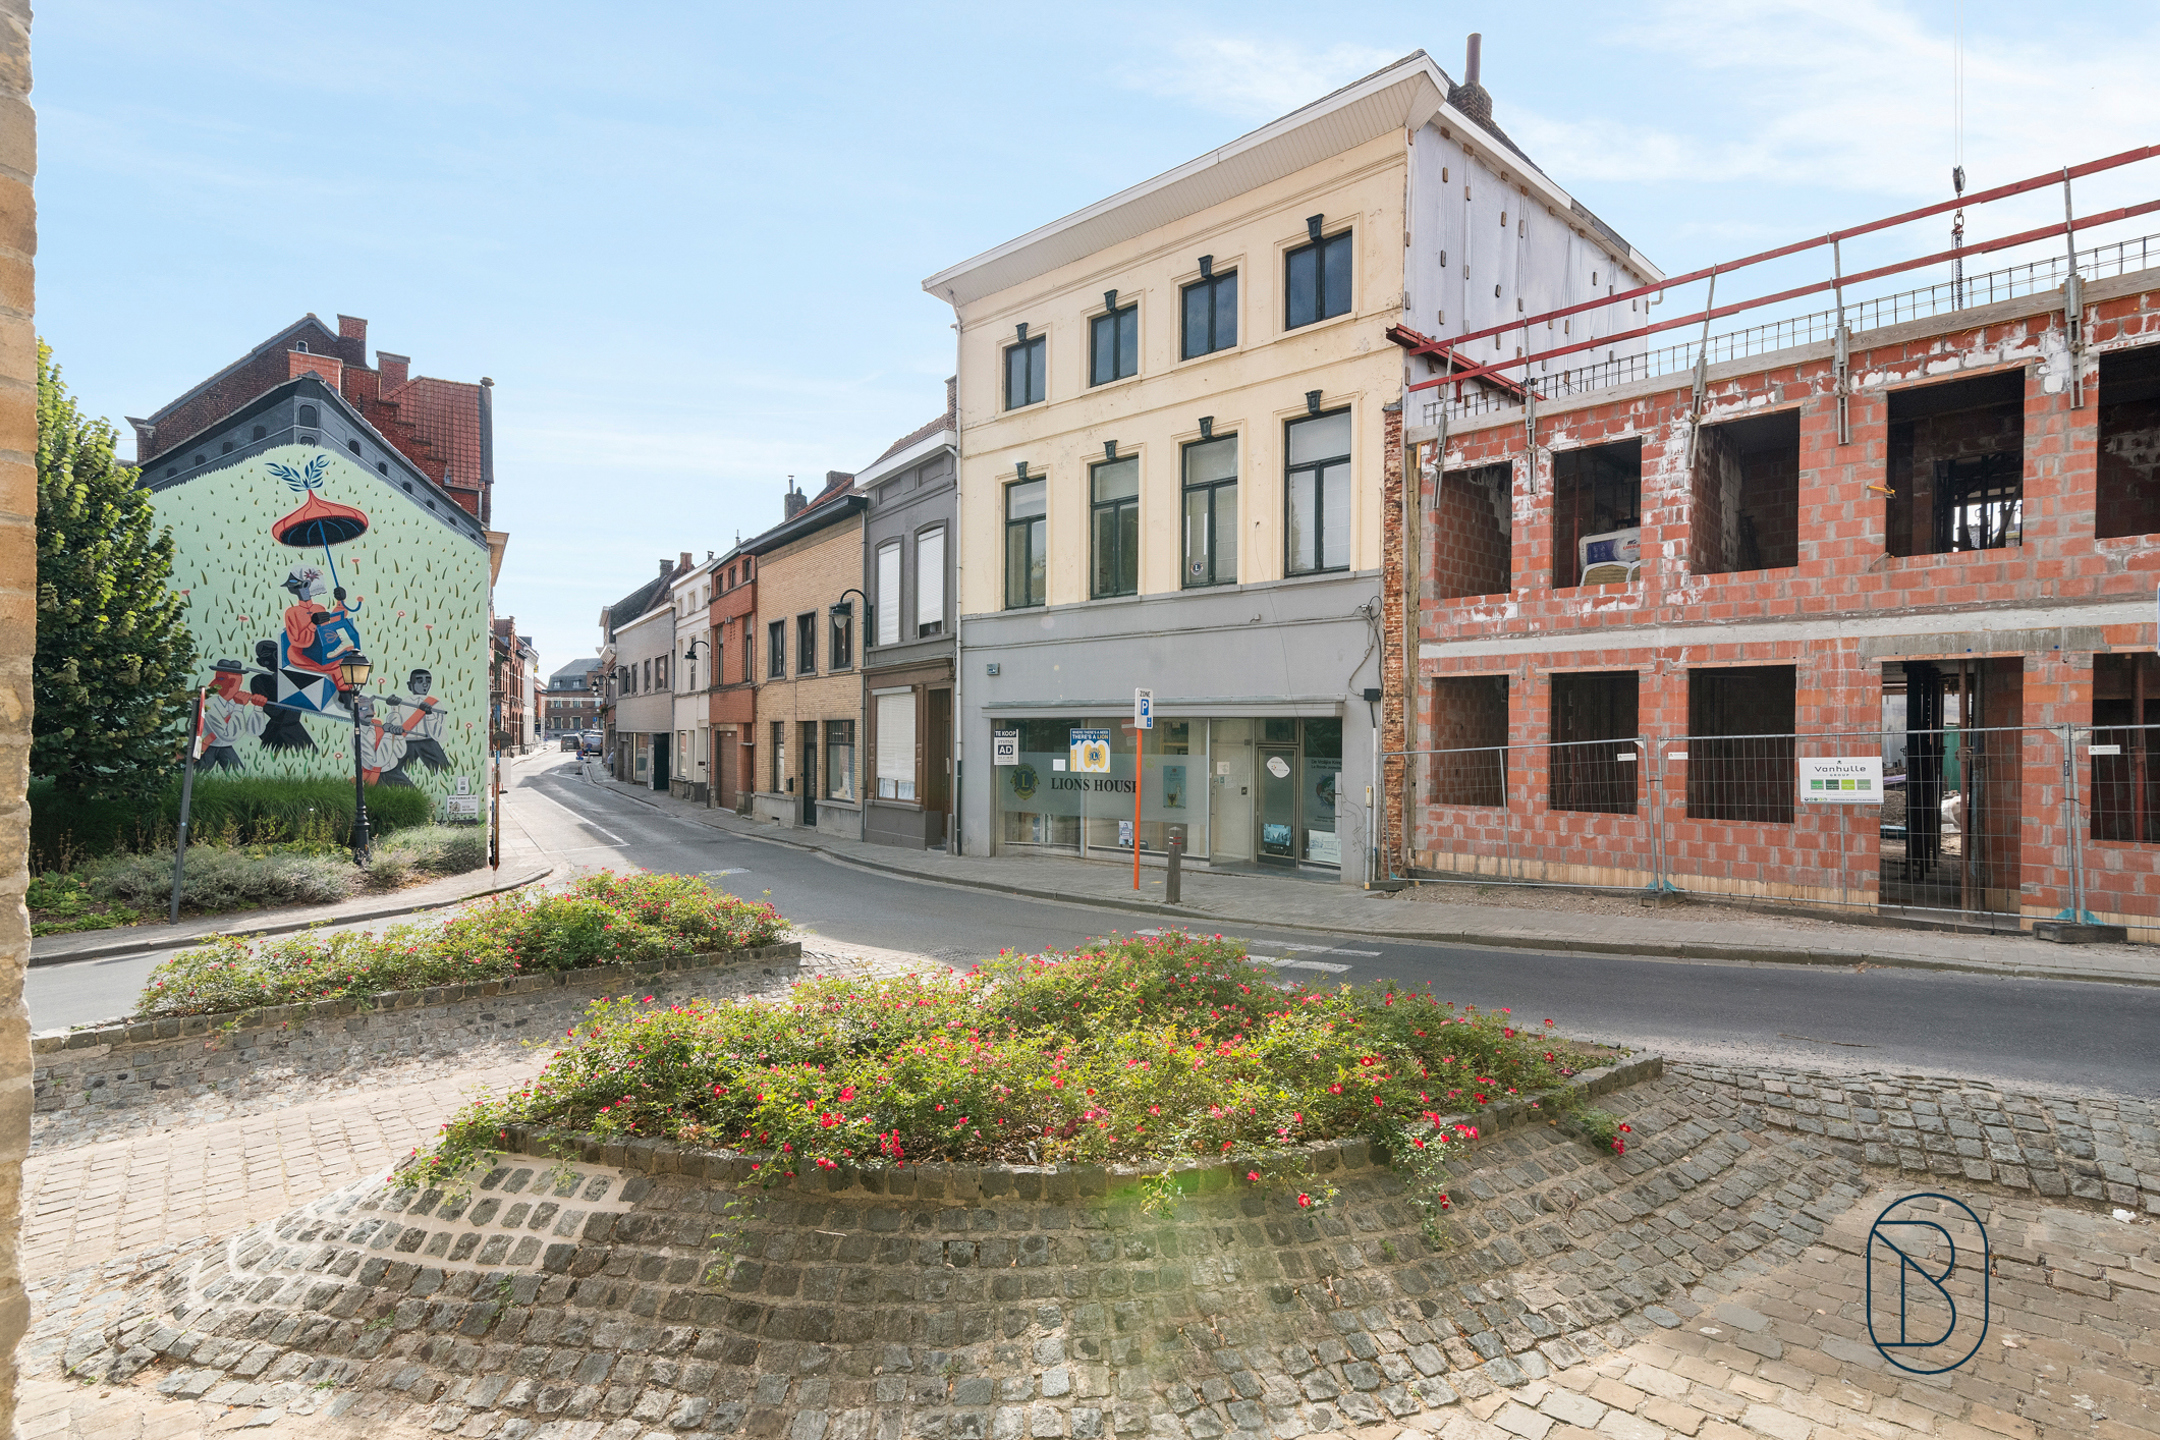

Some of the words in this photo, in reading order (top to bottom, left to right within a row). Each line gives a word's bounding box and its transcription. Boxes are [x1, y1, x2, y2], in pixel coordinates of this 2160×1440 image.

[1139, 690, 1151, 698] ZONE
[1141, 700, 1149, 714] P
[999, 745, 1013, 755] AD
[1070, 740, 1110, 772] 100
[1814, 765, 1867, 773] Vanhulle
[1051, 777, 1090, 791] LIONS
